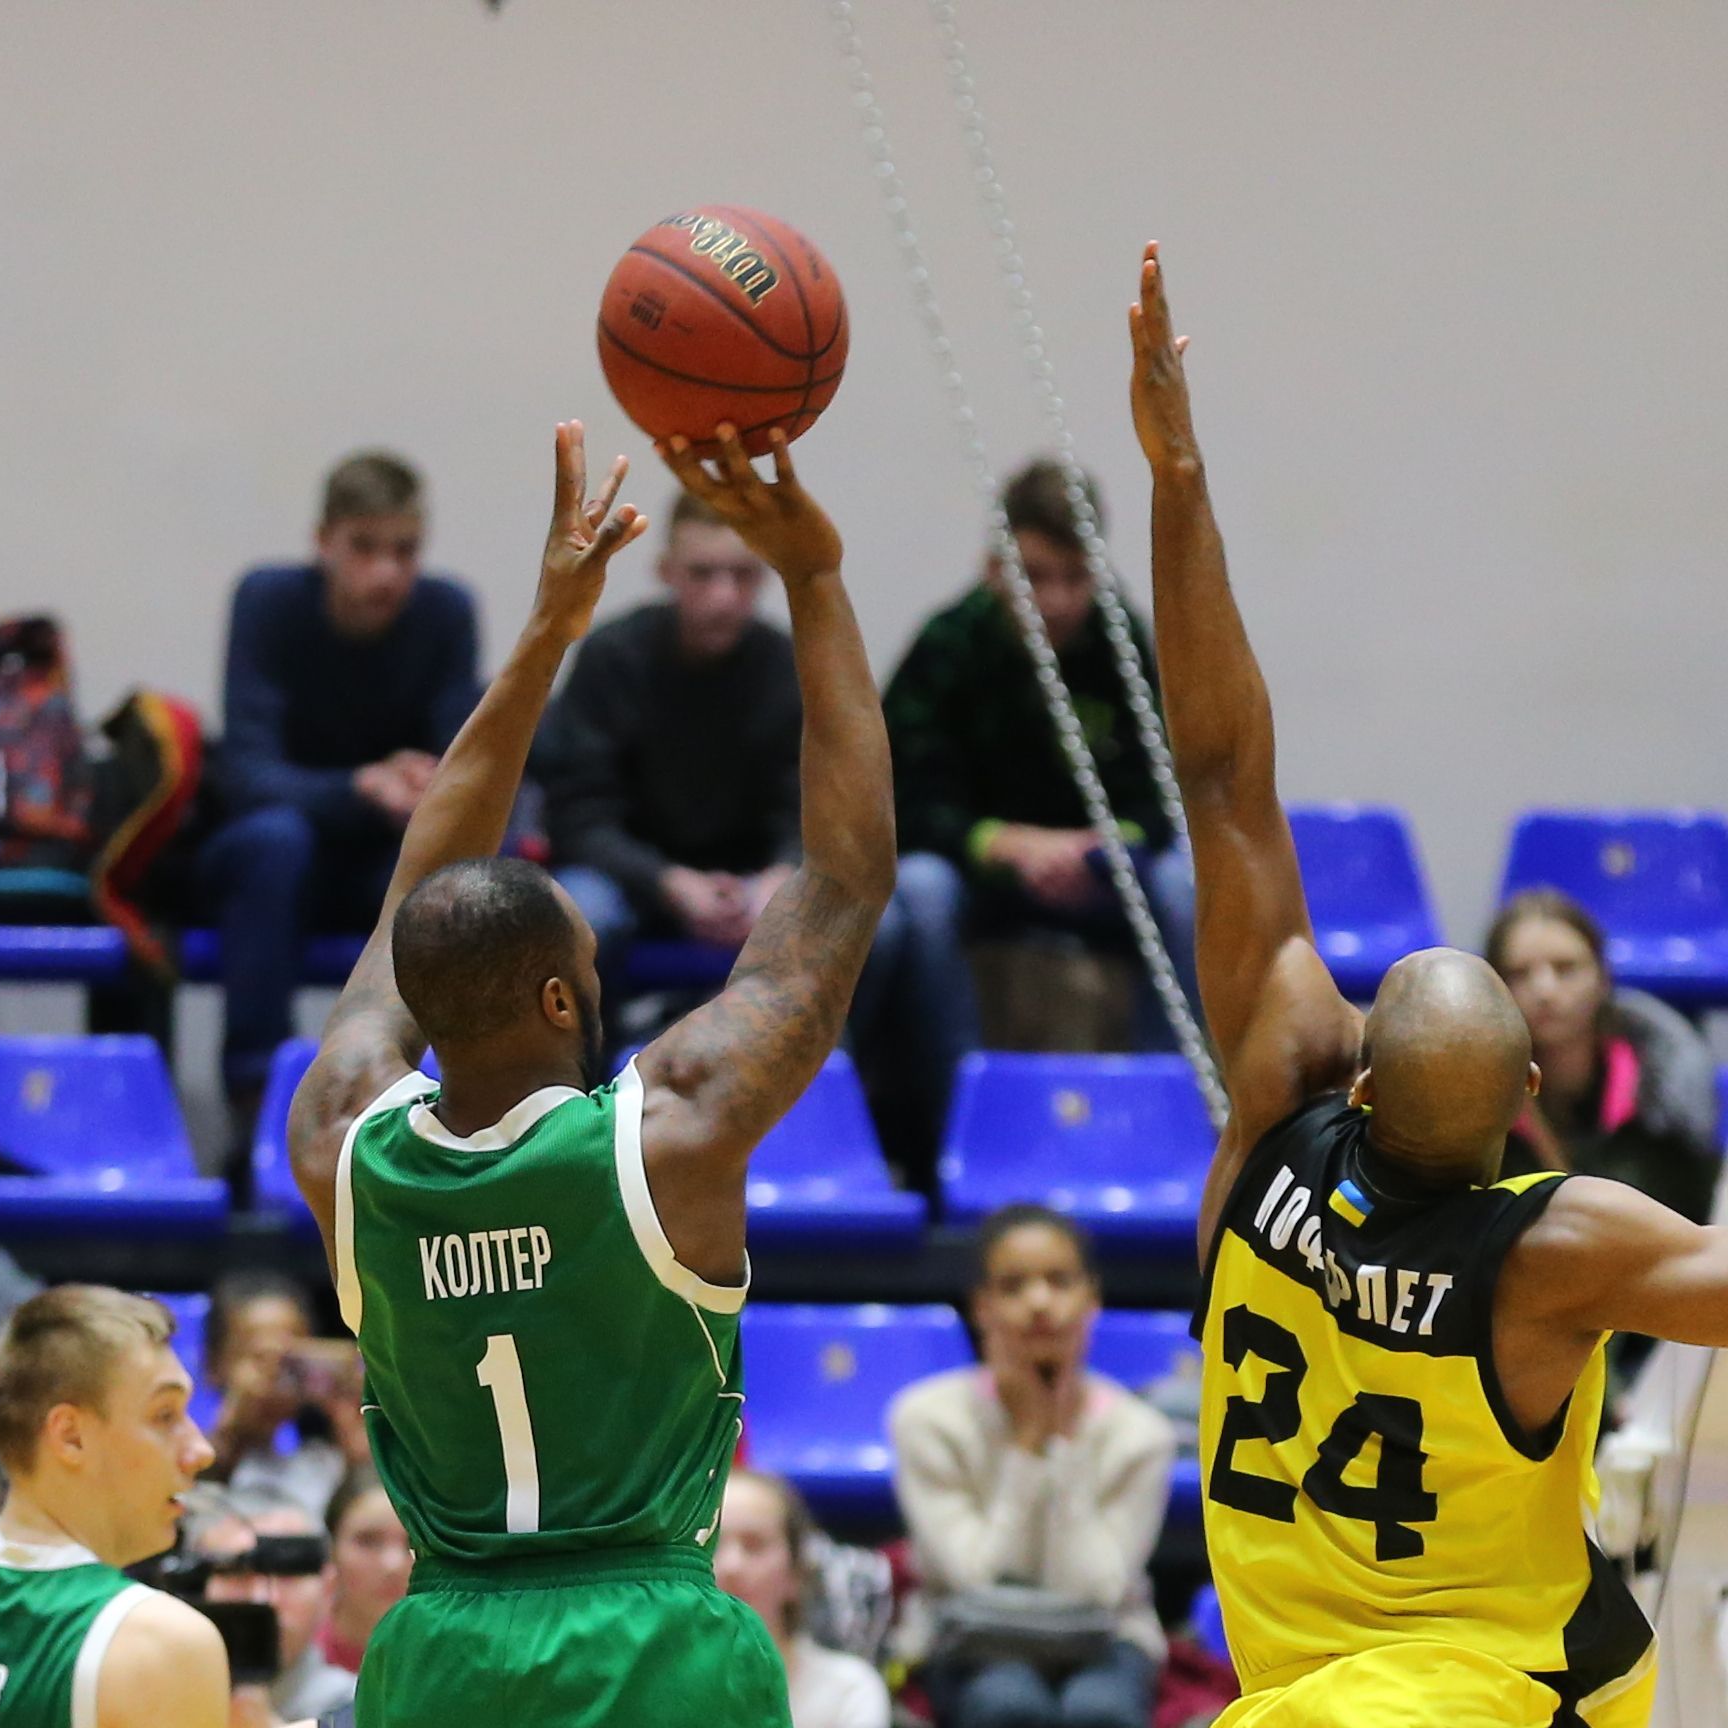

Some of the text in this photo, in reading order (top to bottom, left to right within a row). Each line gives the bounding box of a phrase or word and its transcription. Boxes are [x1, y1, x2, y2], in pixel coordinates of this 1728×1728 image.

[418, 1225, 553, 1300] КОЛТЕР
[476, 1334, 540, 1534] 1
[1209, 1304, 1438, 1562] 24
